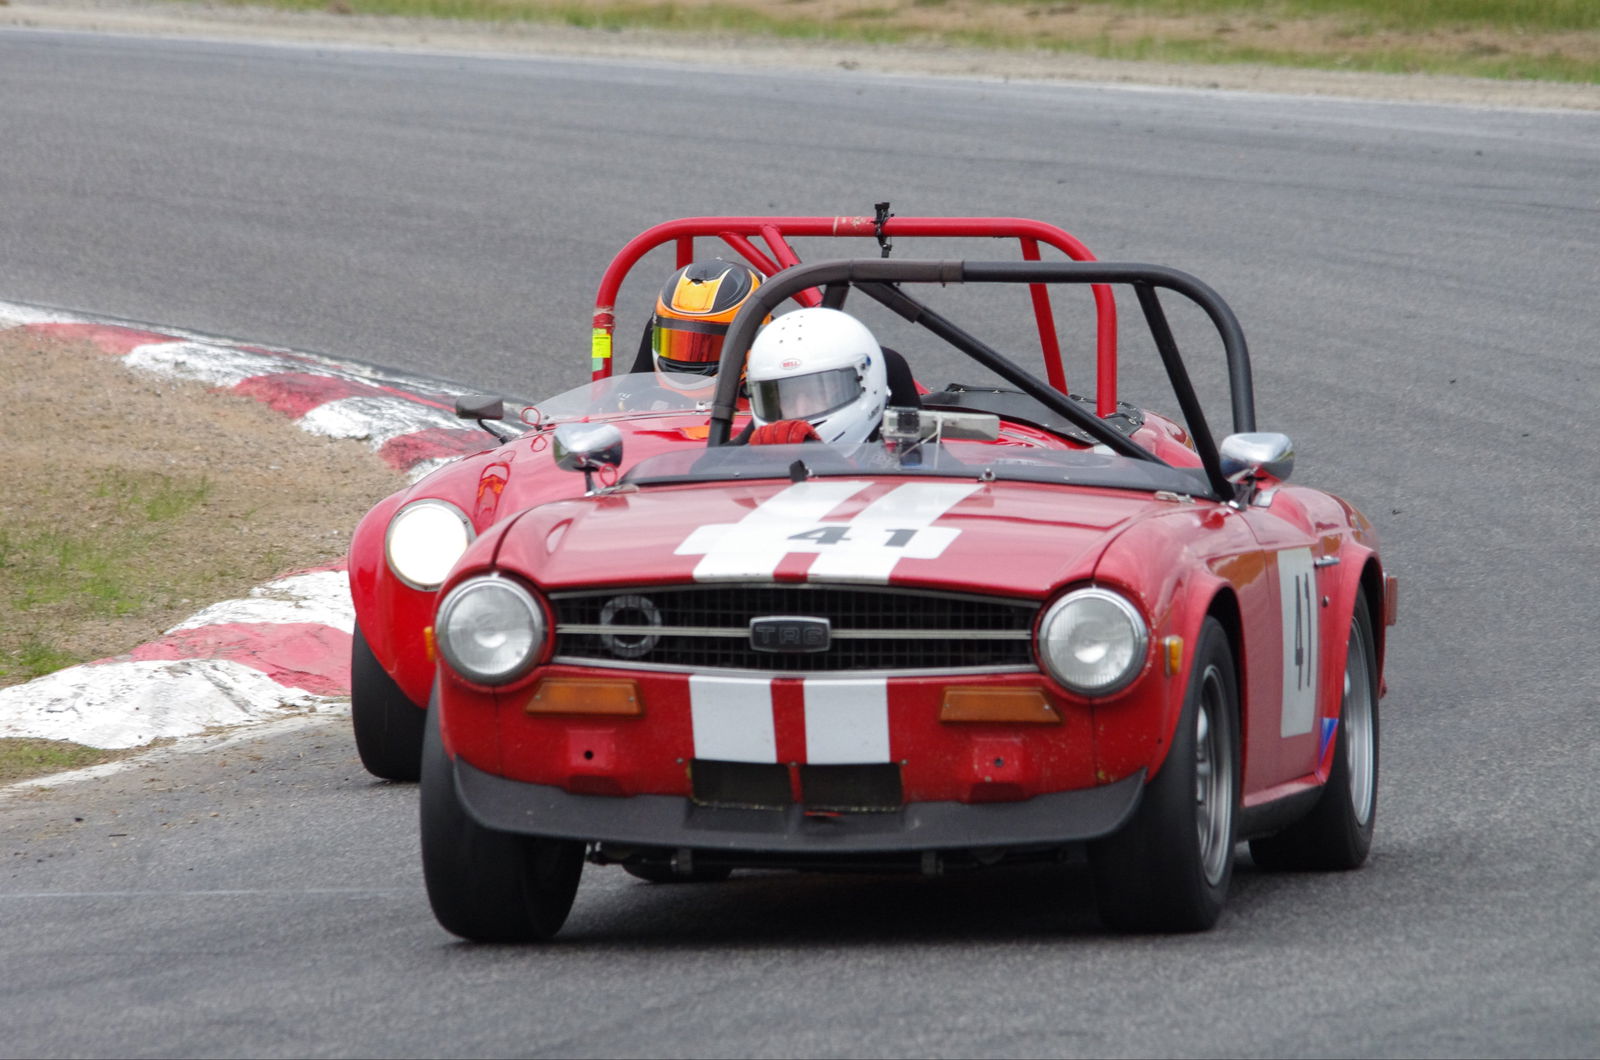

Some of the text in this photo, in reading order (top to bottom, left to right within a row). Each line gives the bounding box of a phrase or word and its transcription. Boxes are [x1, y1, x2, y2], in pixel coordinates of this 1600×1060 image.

[787, 526, 919, 547] 41
[755, 626, 824, 645] TR6
[1294, 572, 1312, 691] 41
